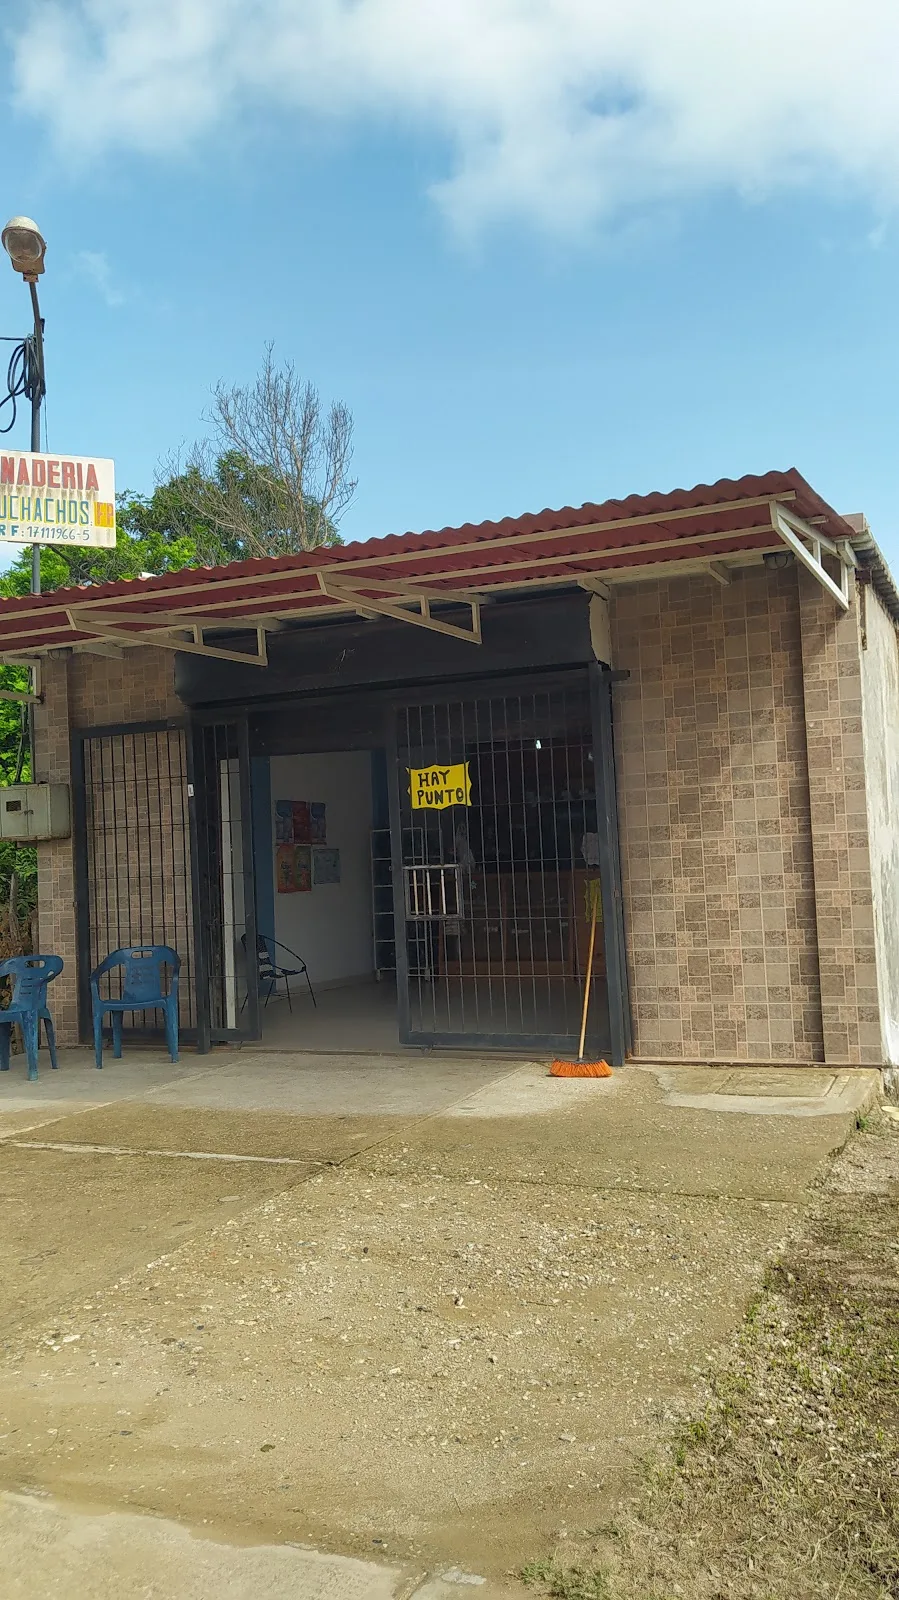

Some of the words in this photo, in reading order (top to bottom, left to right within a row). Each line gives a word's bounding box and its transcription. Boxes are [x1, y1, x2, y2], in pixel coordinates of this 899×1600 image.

[1, 456, 99, 491] NADERIA
[418, 770, 450, 788] HAY
[417, 788, 464, 805] PUNTO
